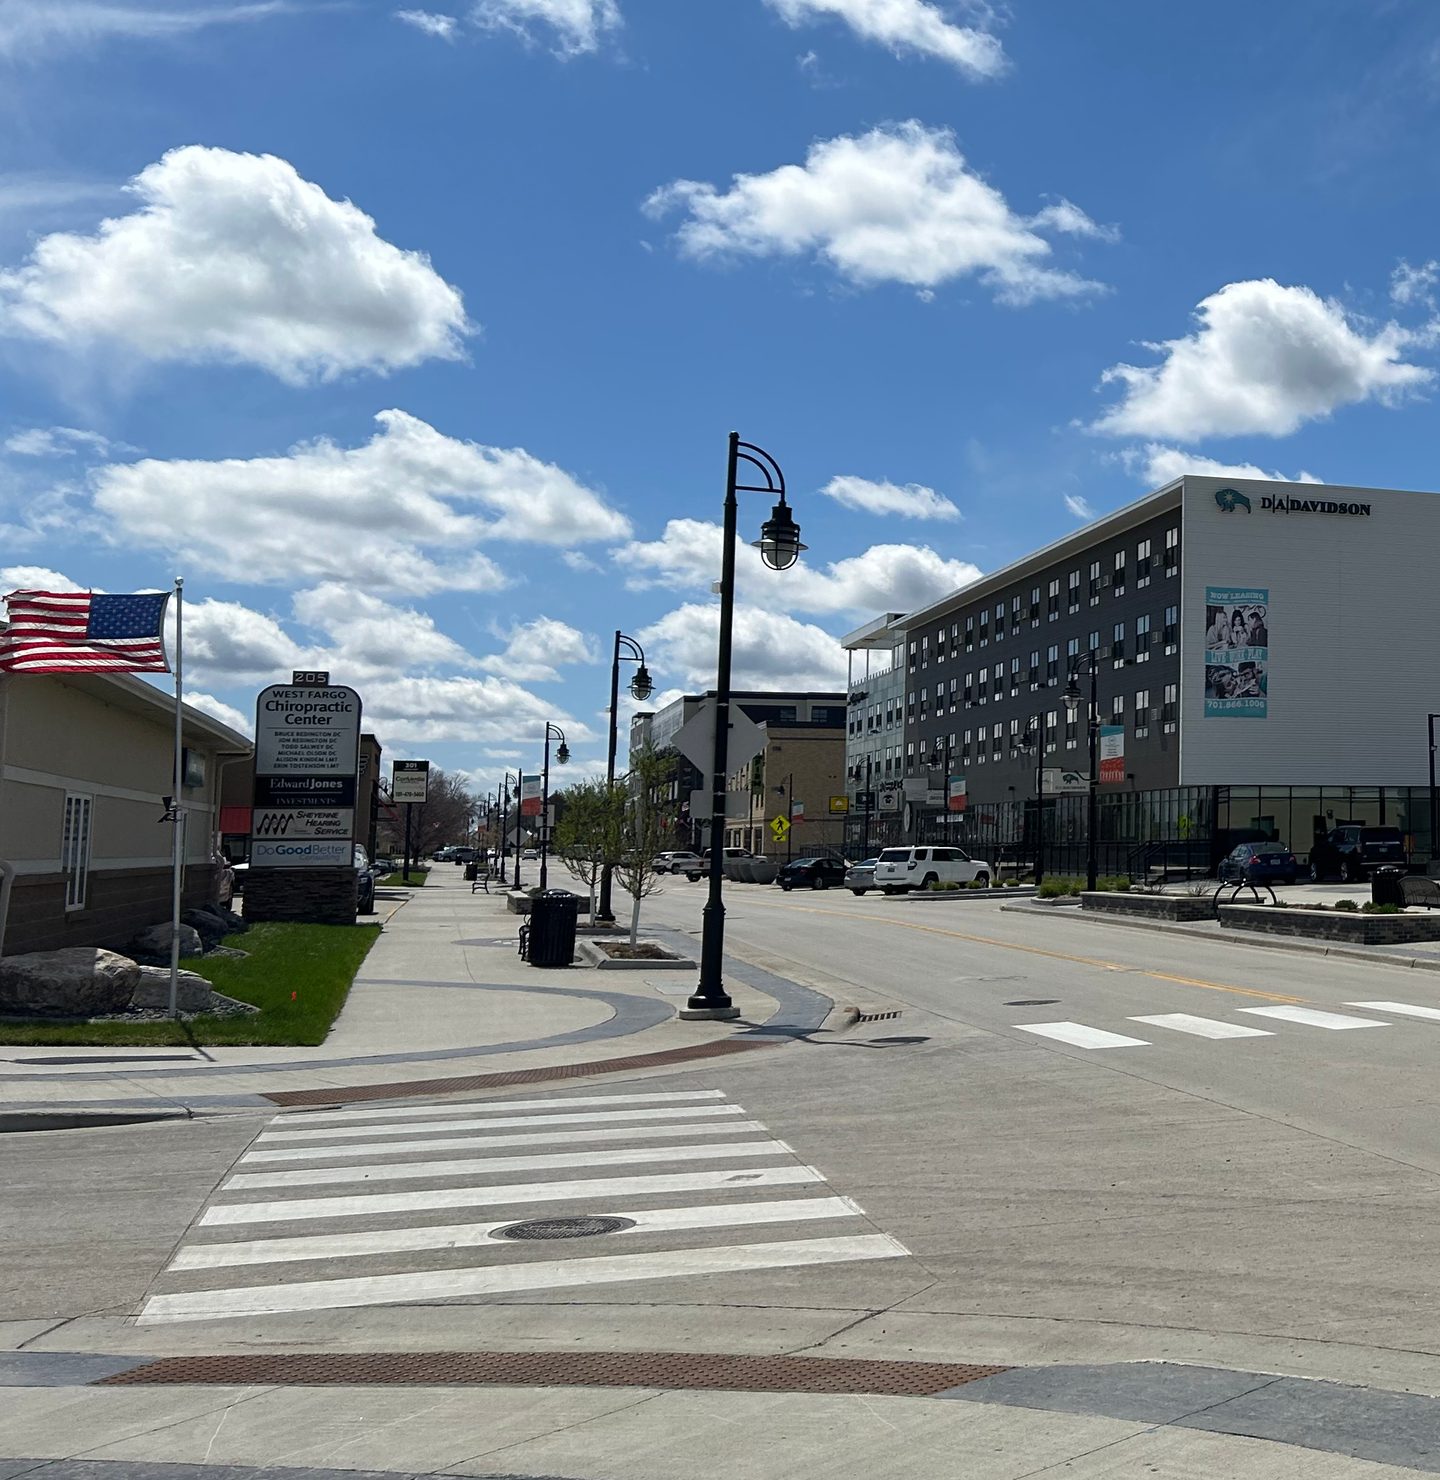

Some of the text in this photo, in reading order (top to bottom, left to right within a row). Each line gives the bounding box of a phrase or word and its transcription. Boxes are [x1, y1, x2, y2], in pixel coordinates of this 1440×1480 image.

[1210, 591, 1264, 600] NOW LEASING
[1210, 651, 1227, 663] LIVE
[1247, 648, 1263, 660] PLAY
[294, 673, 327, 683] 205
[272, 690, 347, 699] WEST FARGO
[265, 700, 353, 714] Chiropractic
[284, 713, 333, 725] Center
[296, 811, 340, 819] SHEYENNE
[305, 819, 341, 827] HEARING
[314, 827, 350, 835] SERVICE
